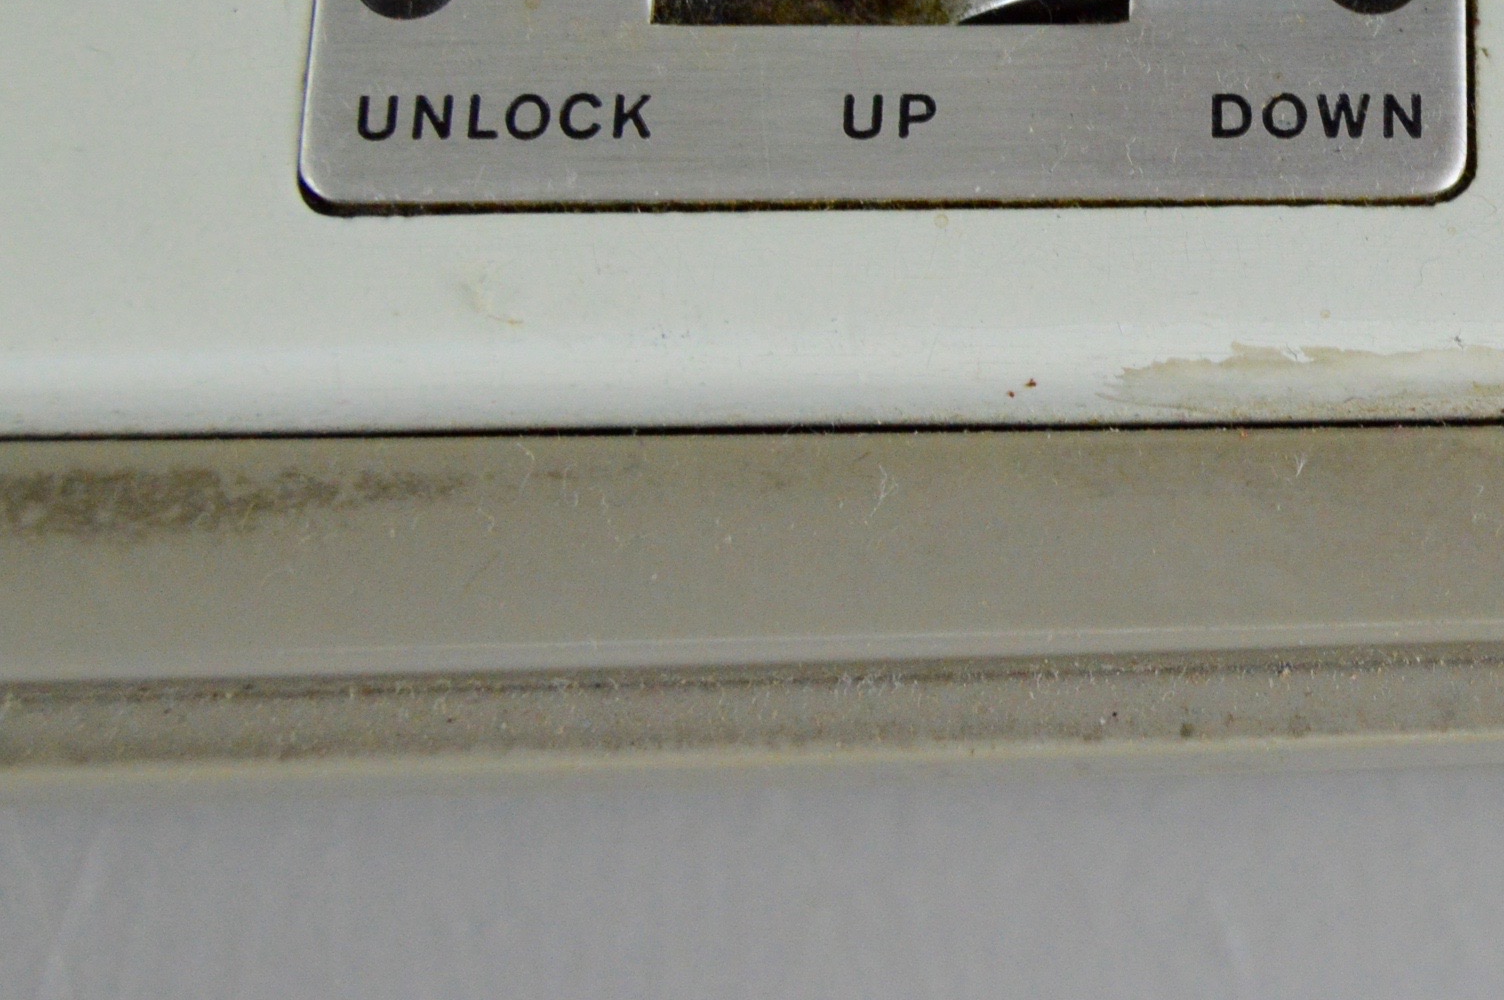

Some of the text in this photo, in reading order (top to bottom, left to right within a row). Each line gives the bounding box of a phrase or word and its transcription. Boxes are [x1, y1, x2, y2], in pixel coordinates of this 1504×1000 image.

[357, 93, 651, 141] UNLOCK
[842, 93, 937, 140] UP
[1211, 92, 1423, 140] DOWN
